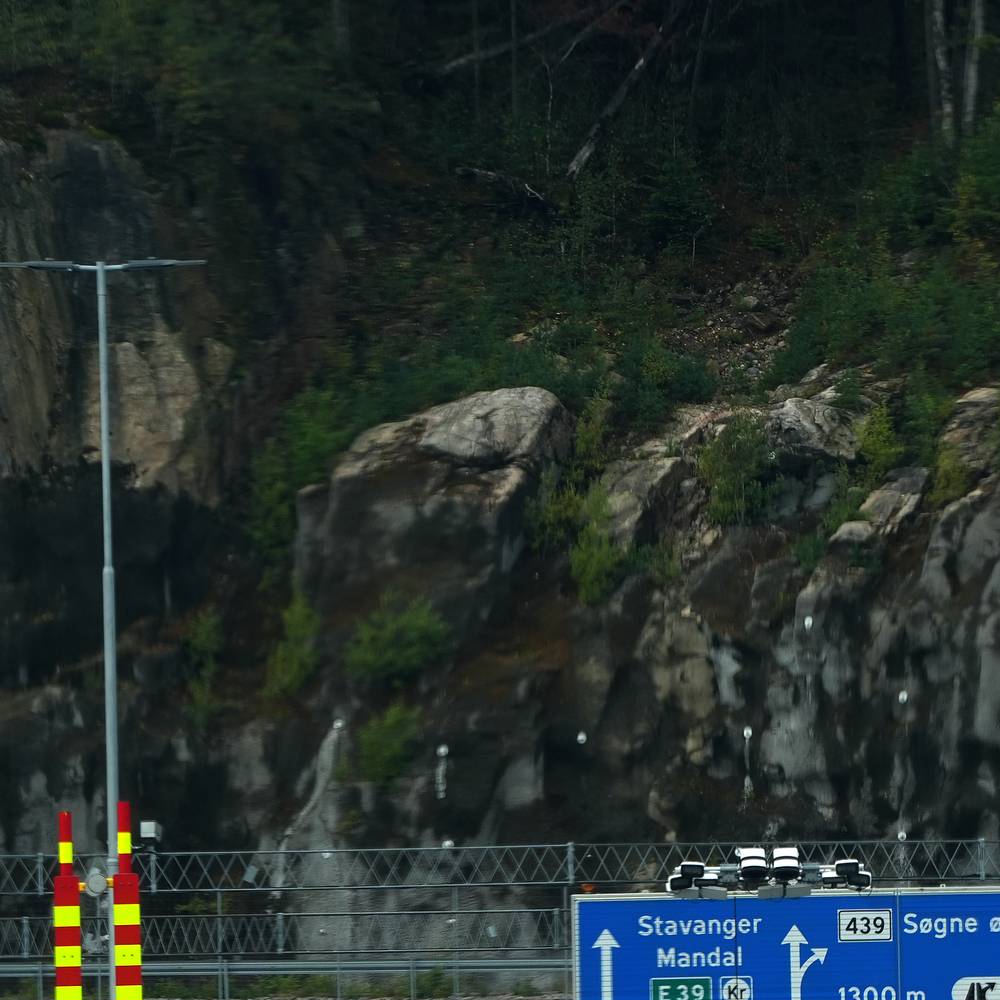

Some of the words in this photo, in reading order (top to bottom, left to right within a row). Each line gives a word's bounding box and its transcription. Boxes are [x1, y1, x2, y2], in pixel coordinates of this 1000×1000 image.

[638, 915, 762, 940] Stavanger
[845, 916, 885, 935] 439
[903, 913, 978, 938] Søgne
[657, 946, 742, 967] Mandal
[727, 984, 746, 1000] Kr
